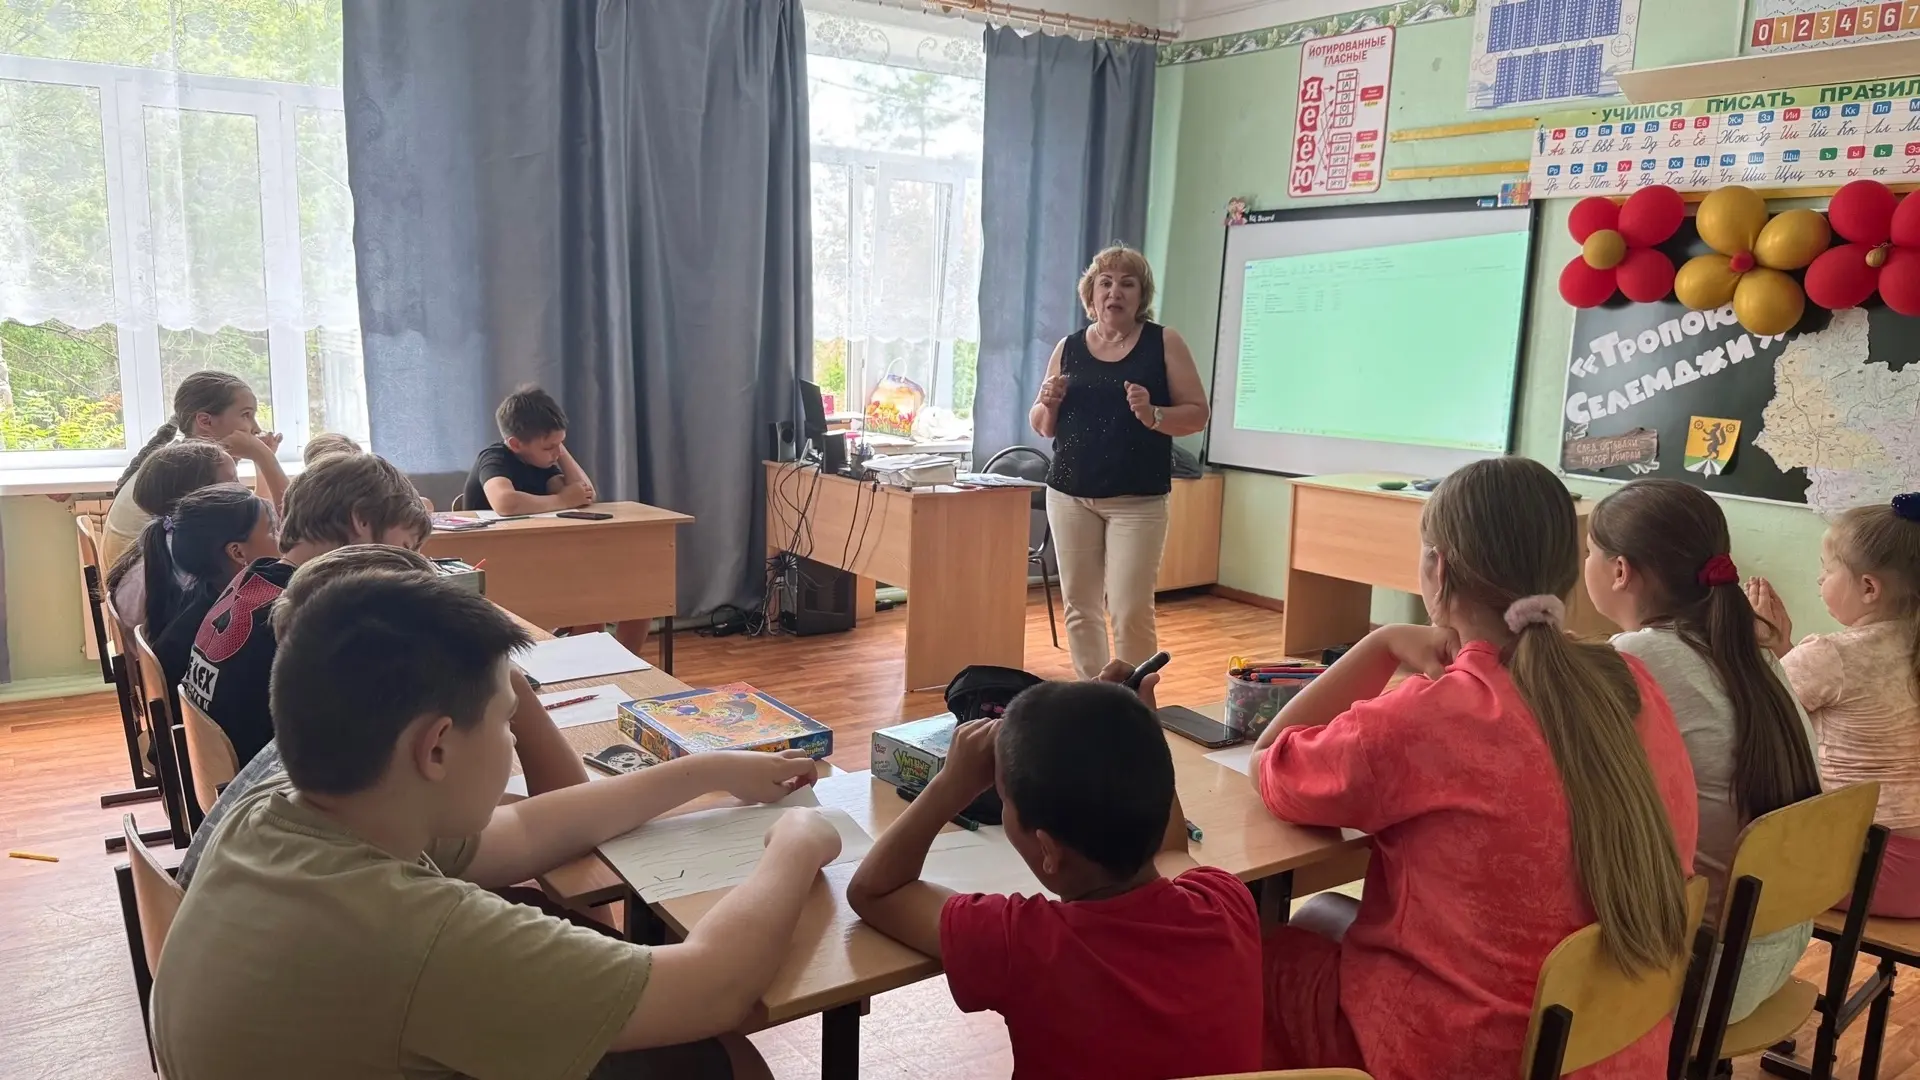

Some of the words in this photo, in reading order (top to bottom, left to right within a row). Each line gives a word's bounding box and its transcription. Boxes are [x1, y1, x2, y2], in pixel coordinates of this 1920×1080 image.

[1758, 24, 1769, 41] 0
[1781, 22, 1787, 38] 1
[1798, 19, 1809, 37] 2
[1820, 16, 1831, 34] 3
[1840, 14, 1851, 31] 4
[1862, 11, 1873, 29] 5
[1884, 8, 1897, 27] 6
[1908, 6, 1920, 24] 7
[1308, 35, 1387, 58] ЙОТИРОВАННЫЕ
[1324, 50, 1368, 66] ГЛАСНЫЕ
[1304, 80, 1320, 100] Я
[1602, 102, 1683, 122] УЧИМСЯ
[1706, 91, 1796, 112] ПИСАТЬ
[1819, 79, 1920, 103] ПРАВИЛ
[1258, 214, 1276, 222] Board
